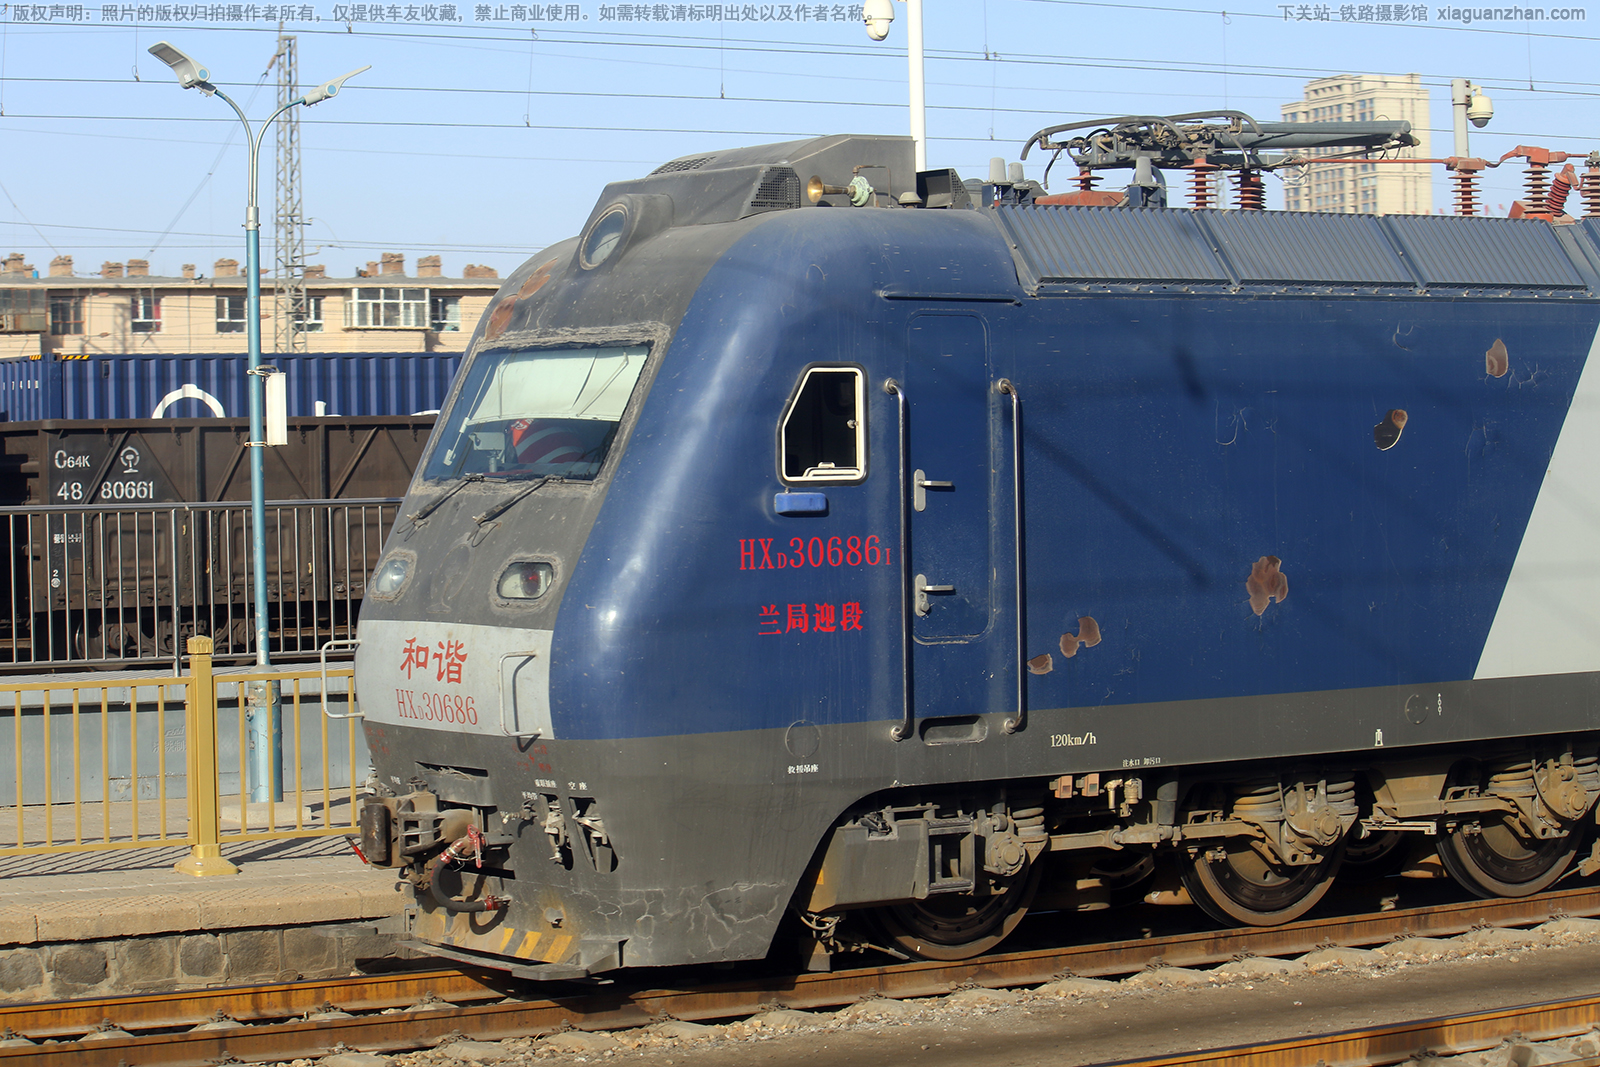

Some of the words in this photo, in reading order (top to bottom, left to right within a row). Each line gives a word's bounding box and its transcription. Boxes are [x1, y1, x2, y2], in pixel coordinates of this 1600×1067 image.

[54, 450, 91, 469] C64K
[57, 482, 83, 500] 48
[101, 481, 154, 499] 80661
[52, 569, 59, 577] 2
[758, 602, 864, 635] 兰局迎段
[400, 637, 468, 684] 和谐
[395, 689, 478, 726] HXD30686
[1050, 732, 1097, 748] 120km/h
